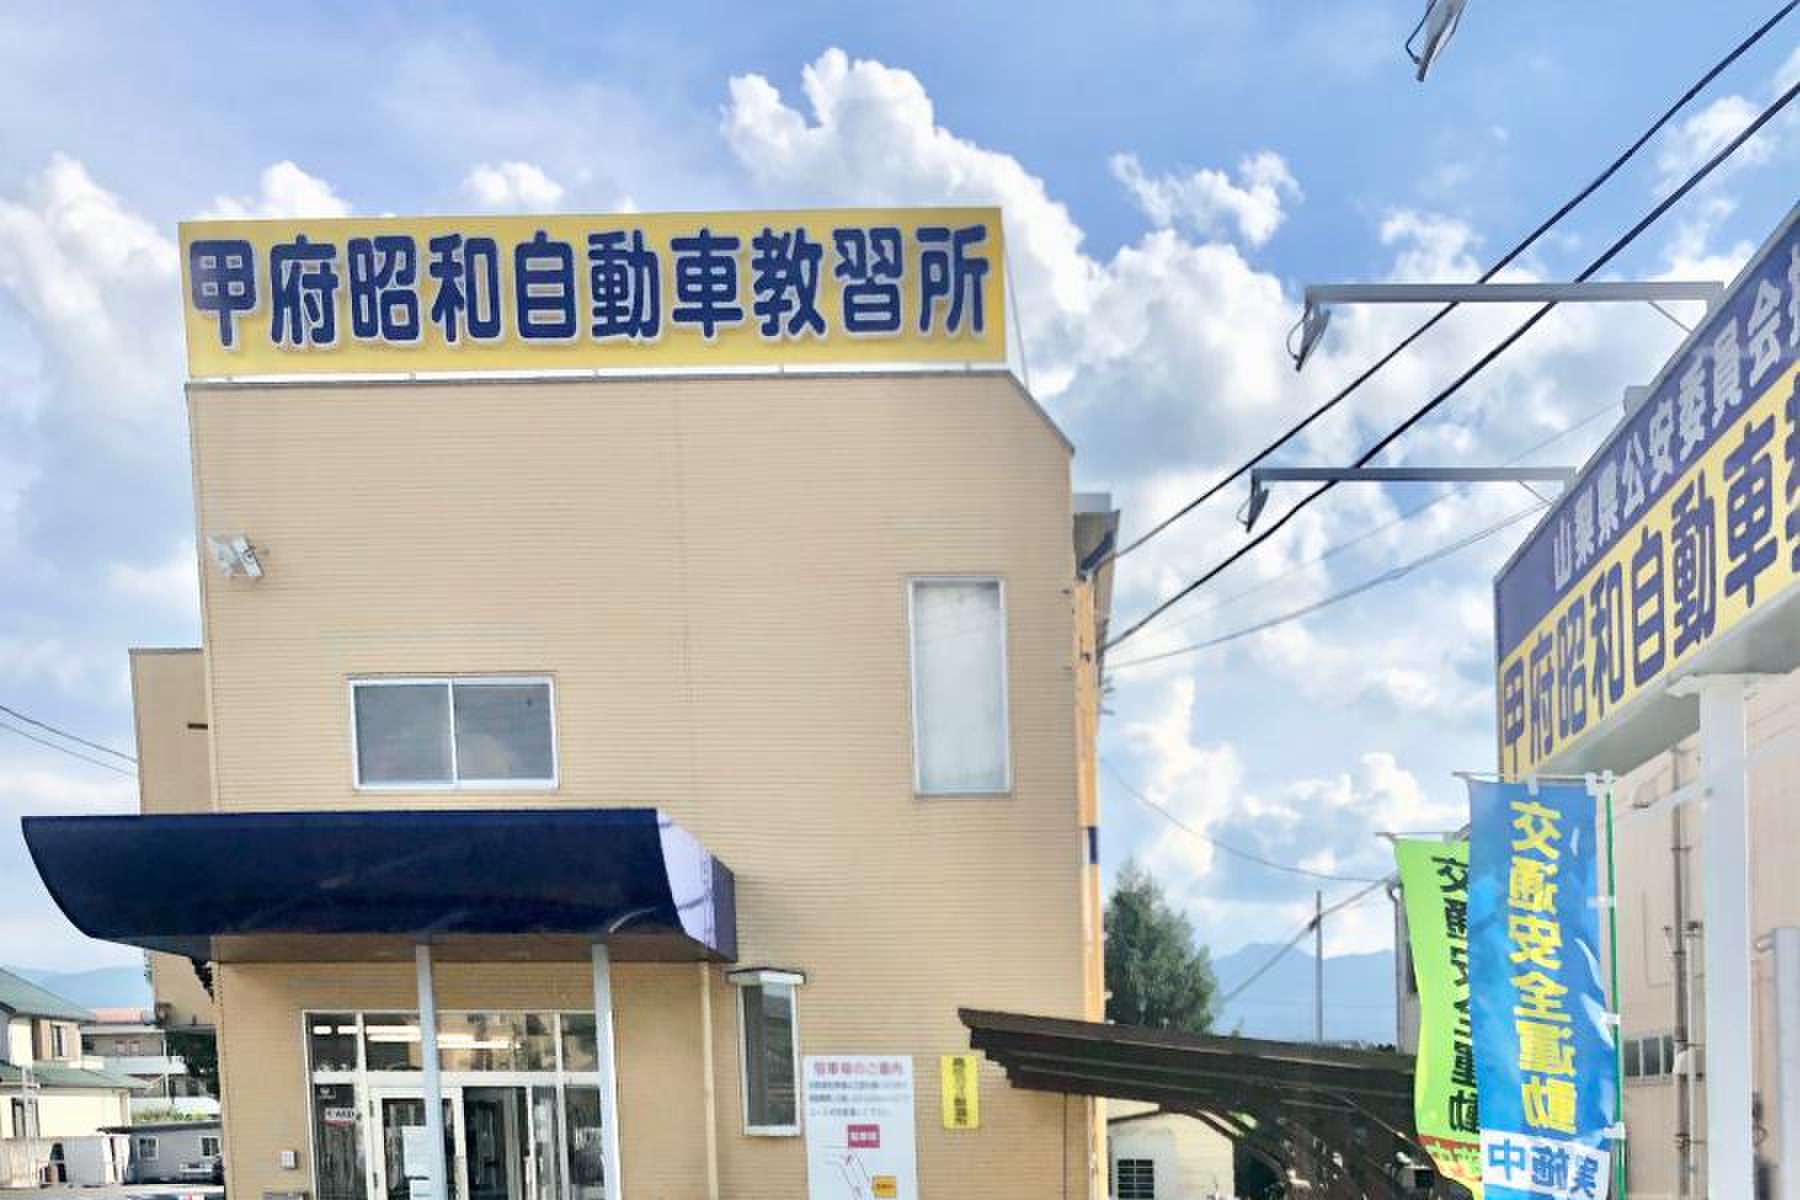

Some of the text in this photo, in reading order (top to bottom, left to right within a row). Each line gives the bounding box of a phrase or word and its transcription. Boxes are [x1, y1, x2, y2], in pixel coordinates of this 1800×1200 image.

[190, 225, 990, 346] 甲府昭和自動車教習所
